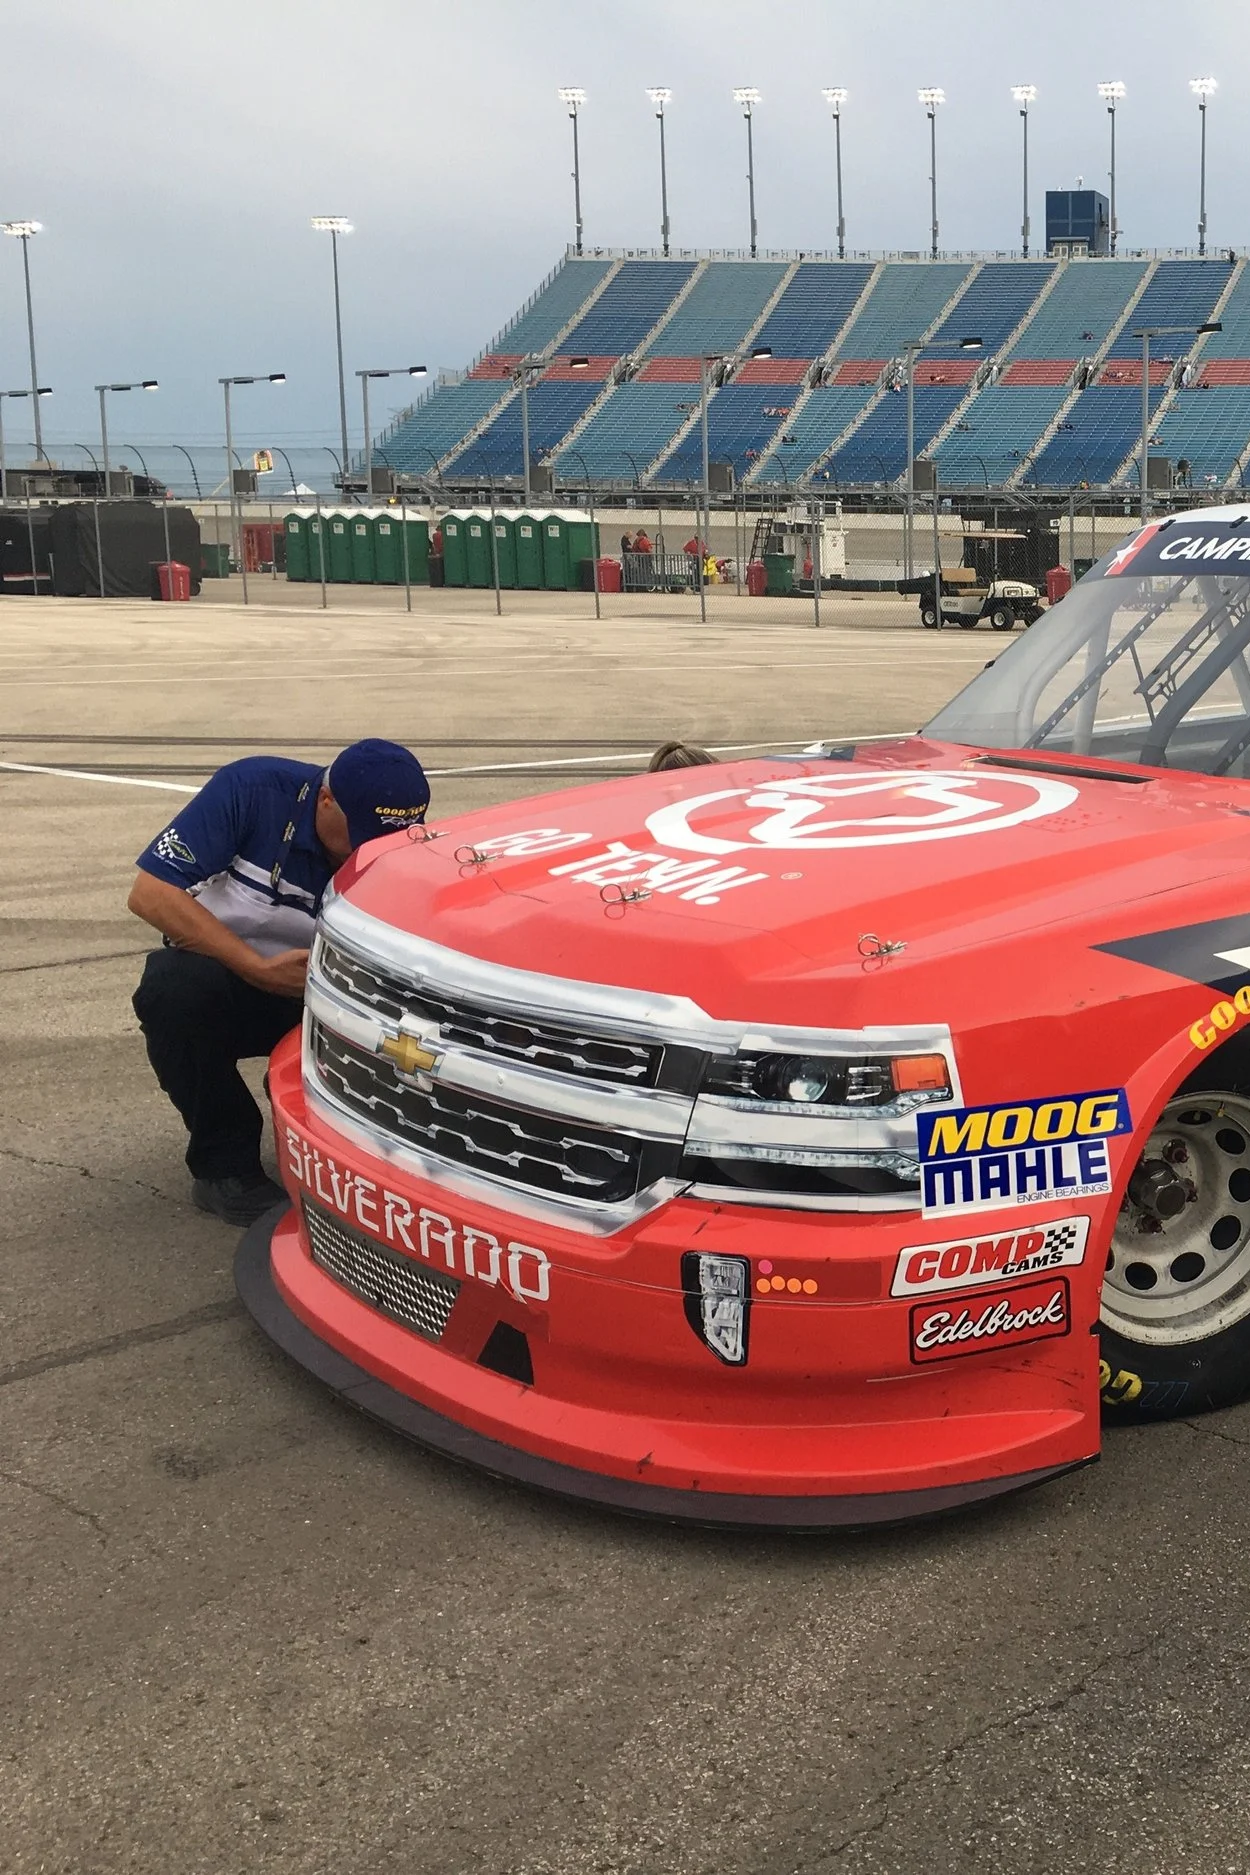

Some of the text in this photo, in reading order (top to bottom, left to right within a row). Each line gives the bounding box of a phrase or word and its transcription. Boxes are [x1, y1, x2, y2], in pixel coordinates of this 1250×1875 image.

[474, 828, 593, 856] GO
[928, 1094, 1119, 1157] MOOG
[923, 1142, 1108, 1208] MAHLE
[1016, 1182, 1110, 1204] ENGINE BEARINGS
[286, 1127, 551, 1301] SILVERADO
[904, 1231, 1045, 1284] COMP
[1001, 1251, 1064, 1276] CAMS
[915, 1291, 1064, 1350] Edelbrock
